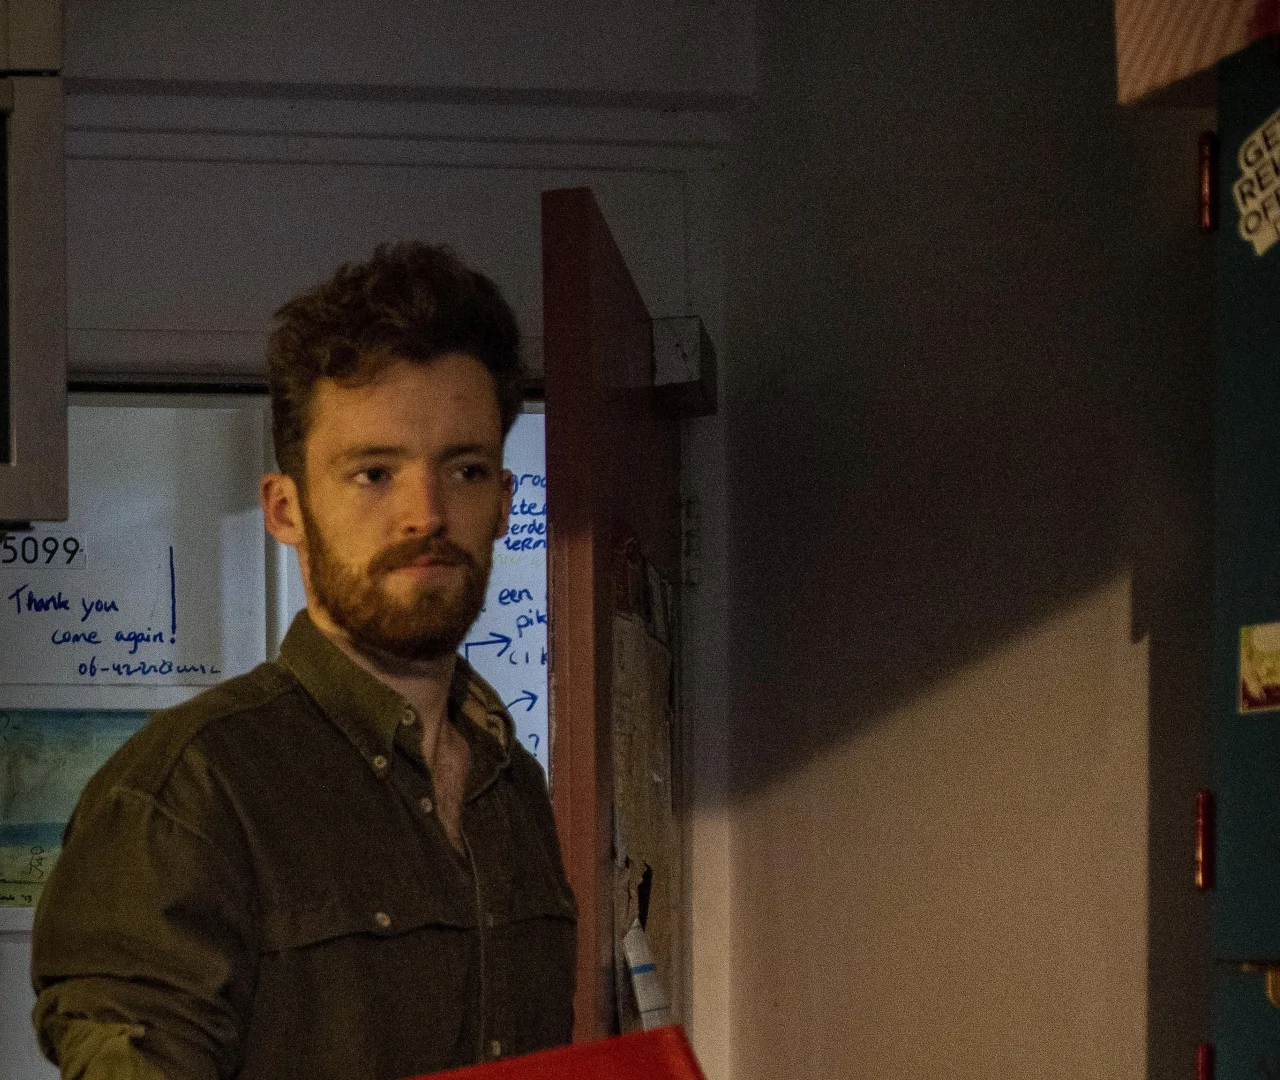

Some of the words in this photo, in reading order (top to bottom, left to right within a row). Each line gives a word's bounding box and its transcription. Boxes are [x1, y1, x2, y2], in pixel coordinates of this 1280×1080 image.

[8, 584, 70, 615] Thank
[81, 597, 120, 622] you
[498, 588, 533, 606] een
[51, 629, 101, 645] come
